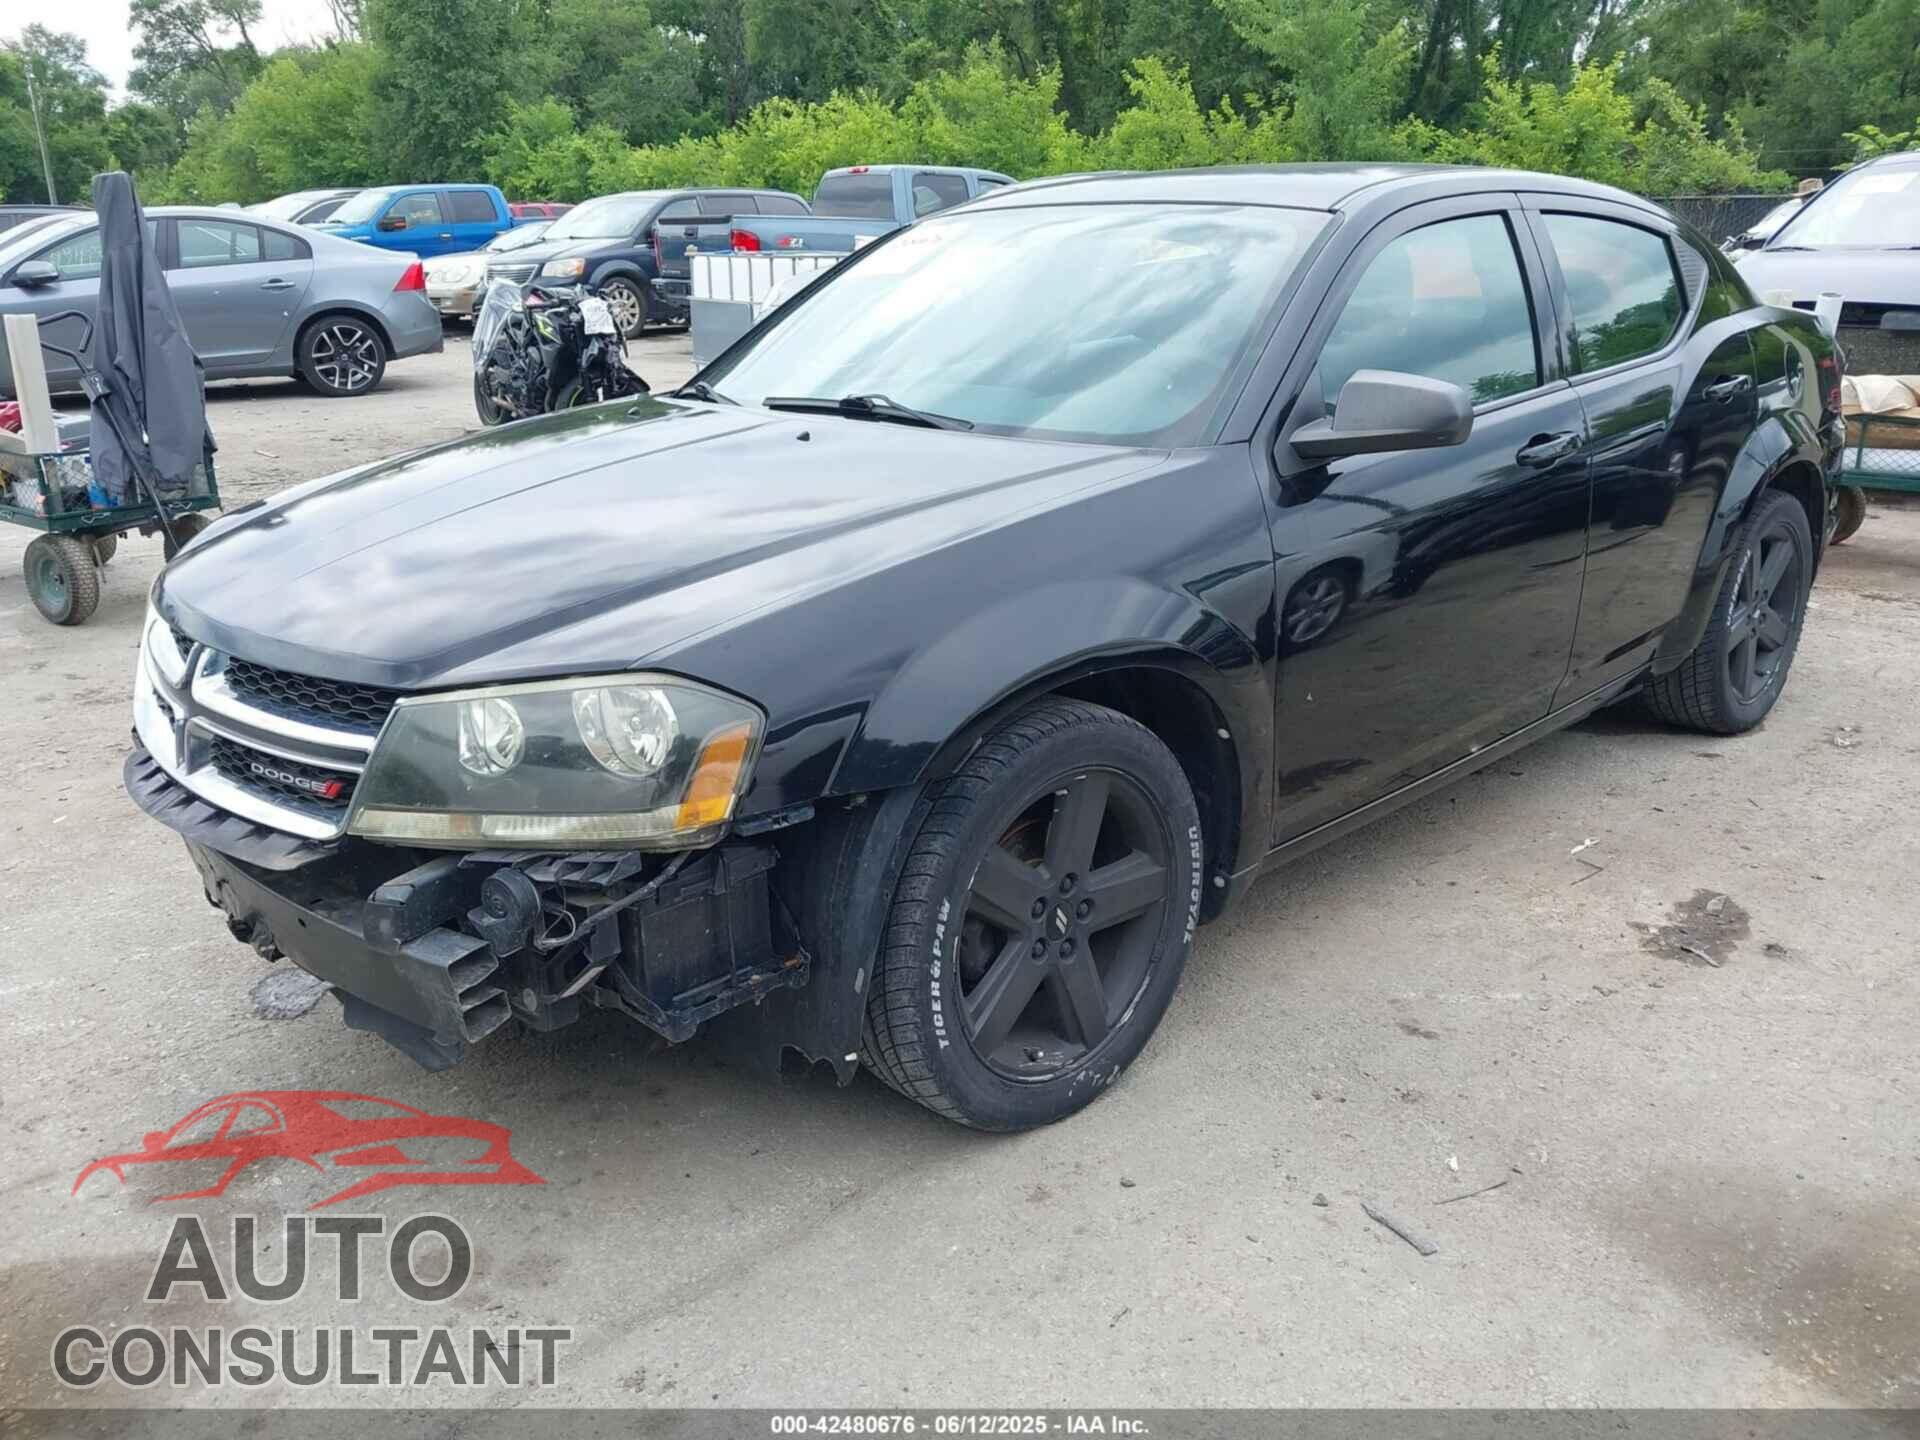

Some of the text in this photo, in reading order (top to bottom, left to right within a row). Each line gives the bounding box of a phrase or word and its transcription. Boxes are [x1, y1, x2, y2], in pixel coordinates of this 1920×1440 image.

[250, 762, 329, 795] DODGE
[1183, 825, 1201, 944] UNIROYAL
[930, 899, 950, 1050] TIGER PAW
